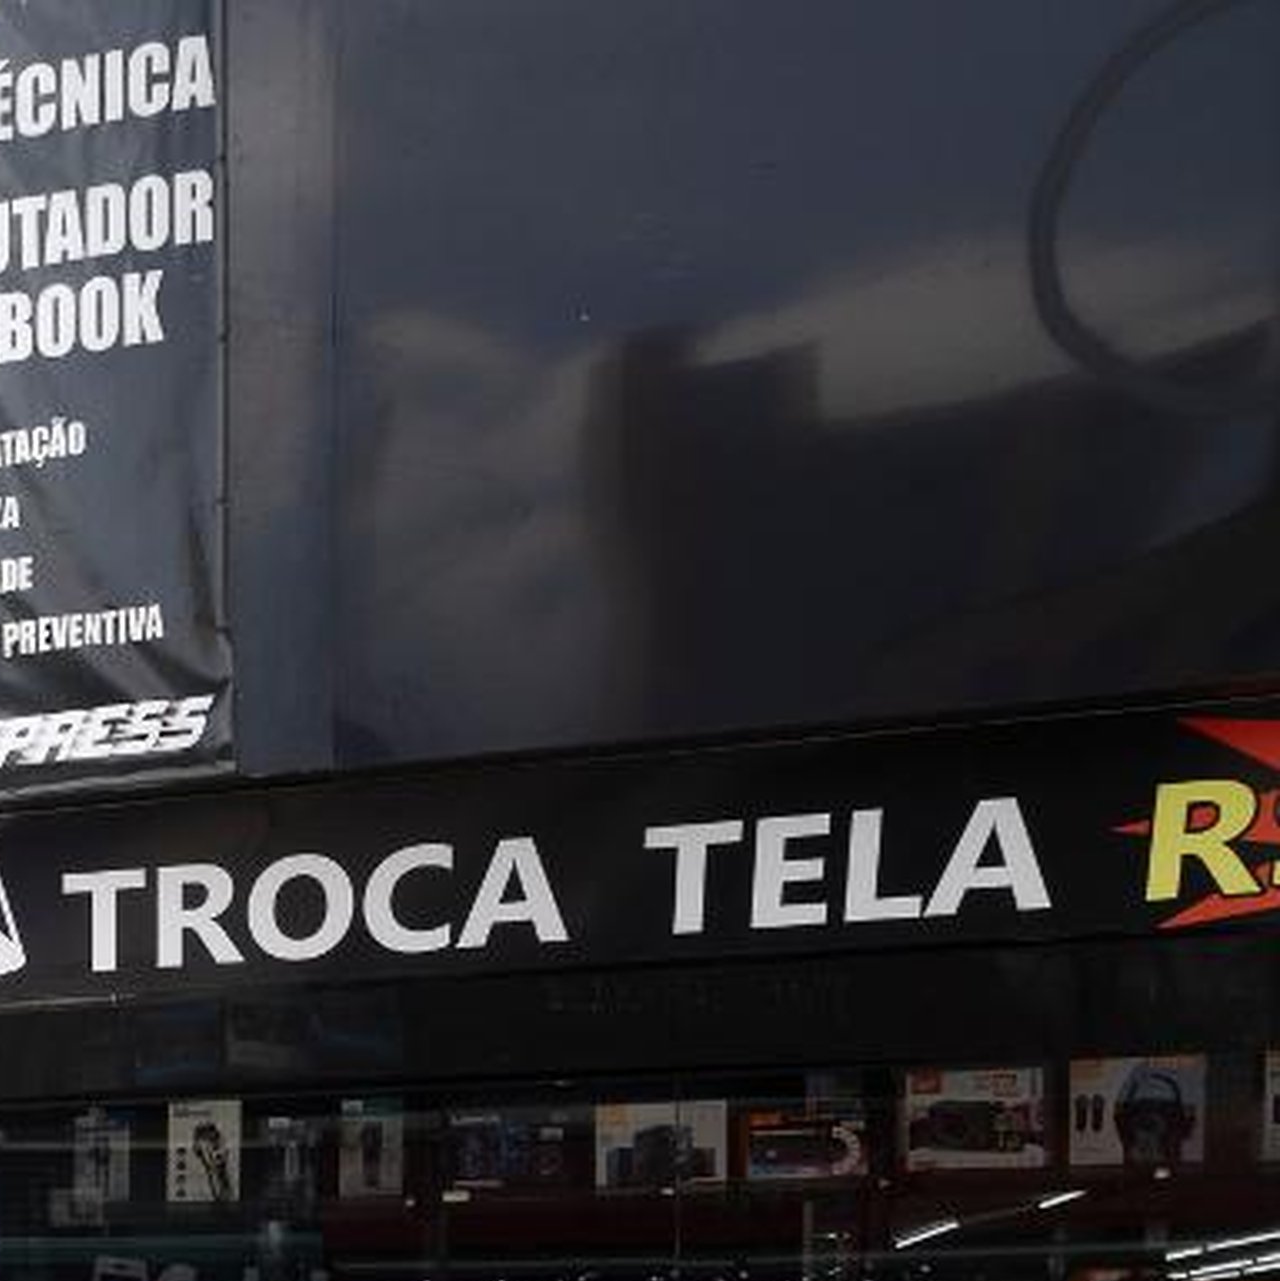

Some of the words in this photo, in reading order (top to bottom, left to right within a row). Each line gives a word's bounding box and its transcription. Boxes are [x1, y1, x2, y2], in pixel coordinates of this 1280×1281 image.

[3, 603, 164, 658] PREVENTIVA
[62, 835, 569, 973] TROCA
[645, 796, 1051, 934] TELA
[1145, 779, 1280, 902] R
